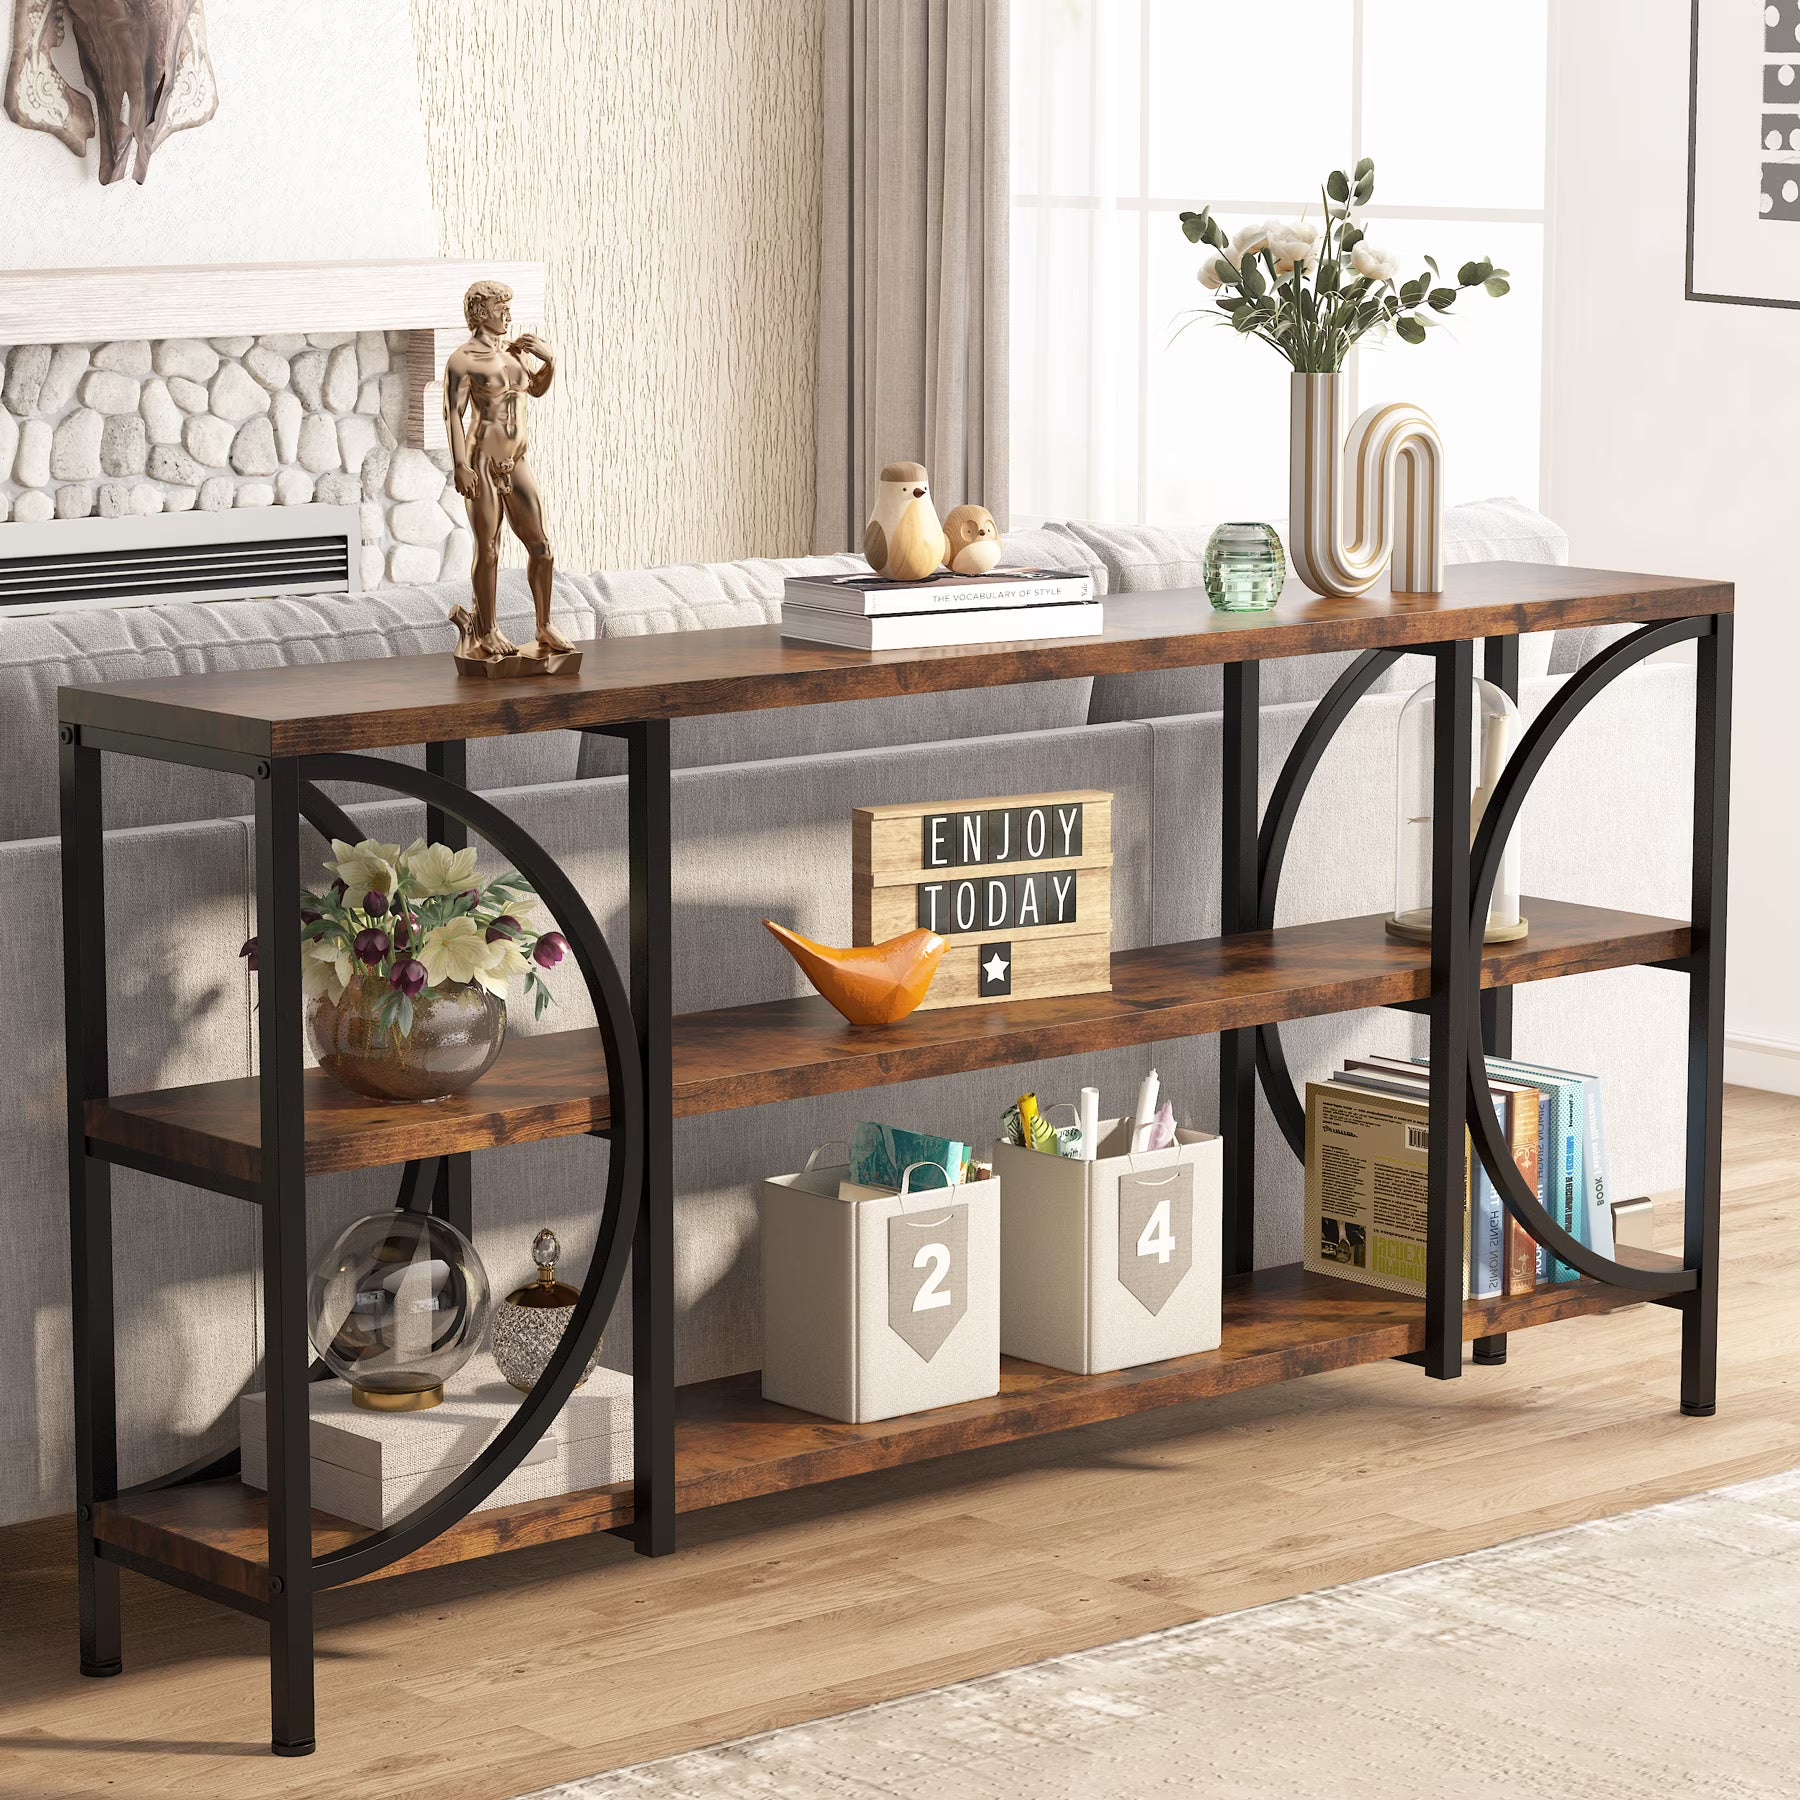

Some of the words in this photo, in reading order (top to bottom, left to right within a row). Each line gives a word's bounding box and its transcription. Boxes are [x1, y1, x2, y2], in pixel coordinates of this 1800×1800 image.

[933, 595, 950, 603] THE
[953, 591, 1016, 601] VOCABULARY
[1034, 588, 1062, 596] STYLE
[931, 808, 1078, 865] ENJOY
[925, 875, 1073, 932] TODAY
[1136, 1200, 1176, 1265] 4
[912, 1243, 952, 1312] 2
